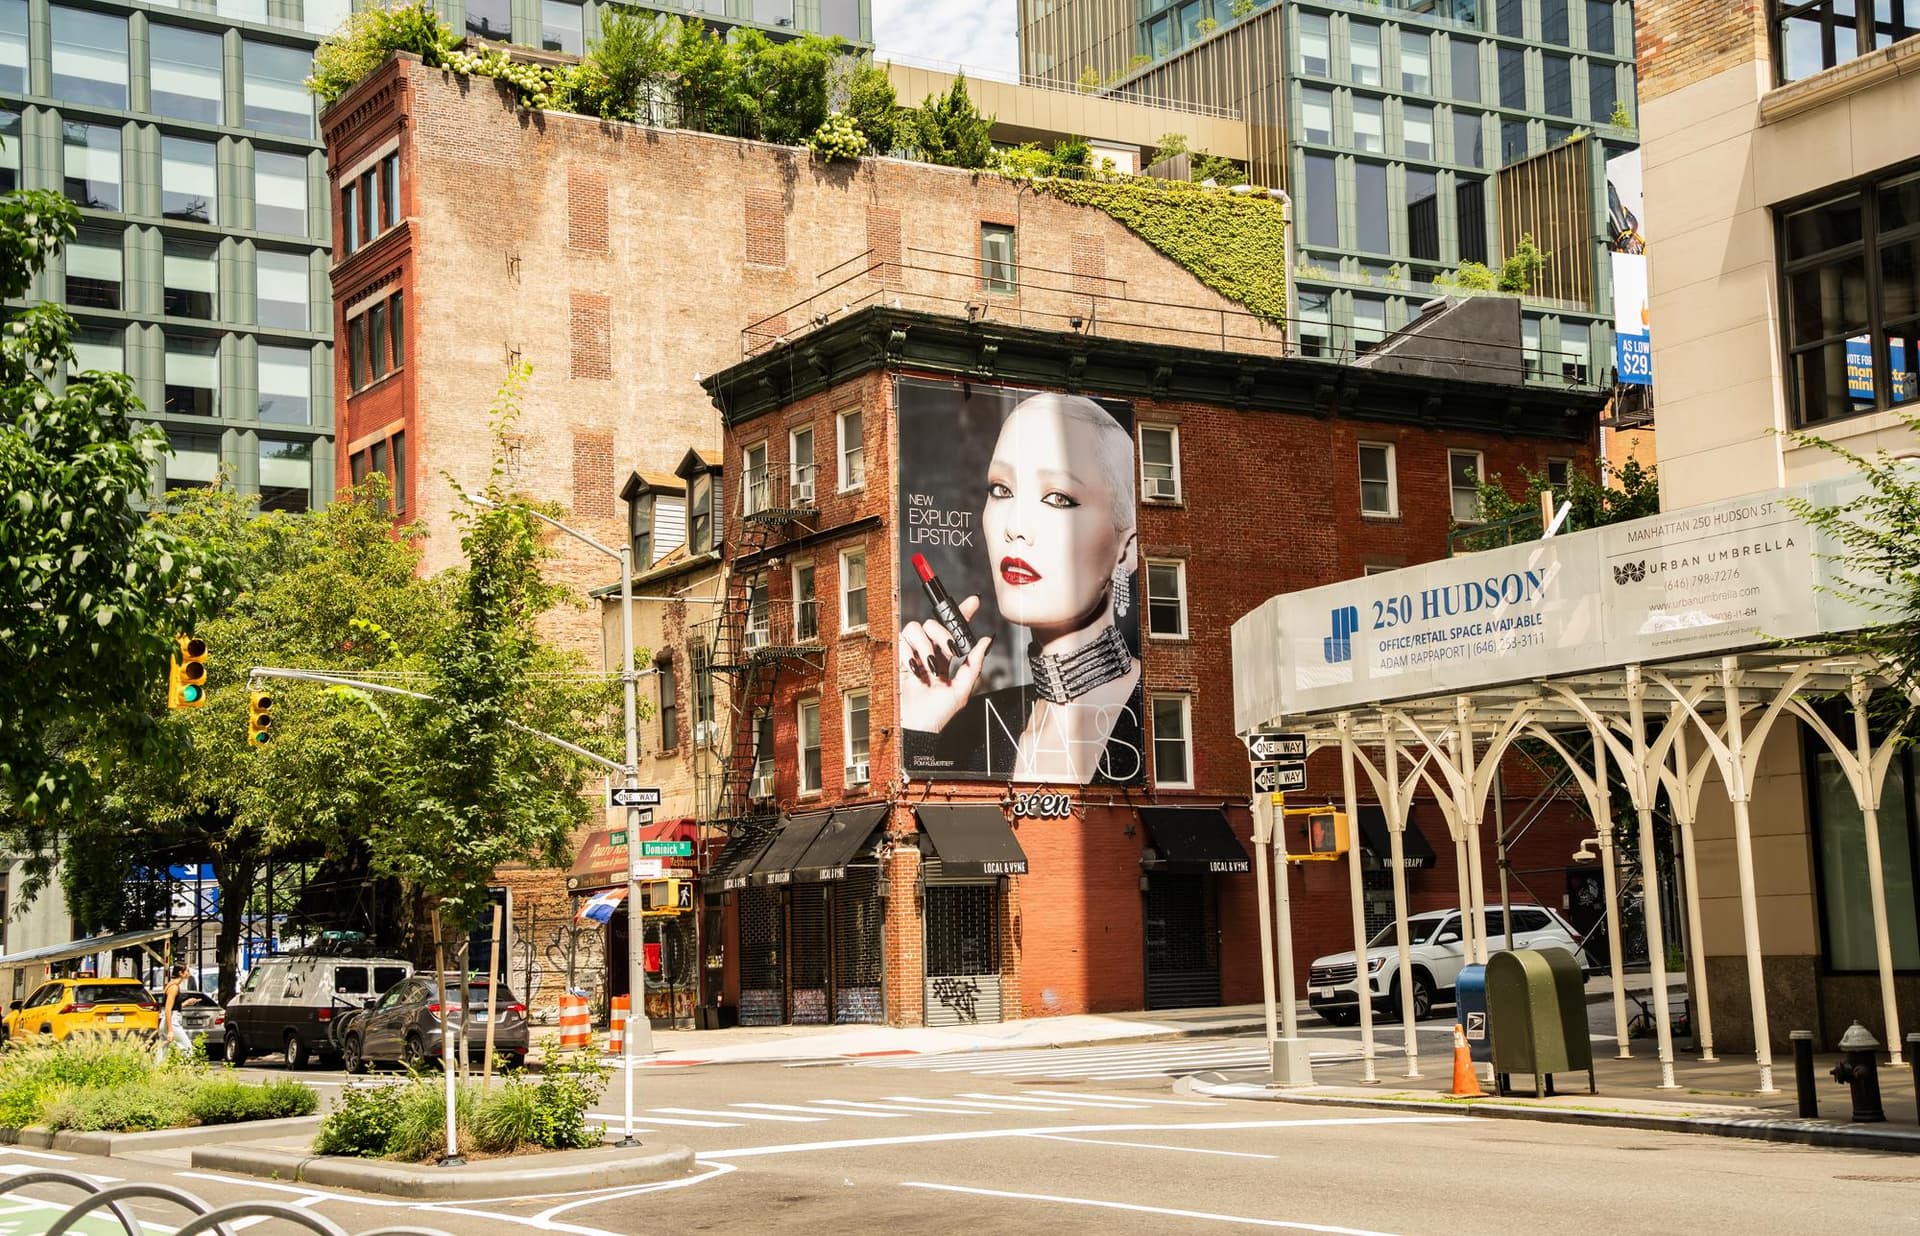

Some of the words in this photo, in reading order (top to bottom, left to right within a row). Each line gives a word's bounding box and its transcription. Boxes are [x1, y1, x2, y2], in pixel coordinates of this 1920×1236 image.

[1623, 339, 1632, 352] AS
[1634, 341, 1650, 353] LOW
[1847, 353, 1860, 365] VOTE
[909, 493, 934, 506] NEW
[909, 508, 972, 528] EXPLICIT
[1627, 520, 1690, 543] MANHATTAN
[1692, 515, 1711, 529] 250
[1714, 505, 1758, 524] HUDSON
[1761, 502, 1776, 516] ST.
[909, 527, 973, 547] LIPSTICK
[1650, 555, 1700, 574] URBAN
[1708, 537, 1795, 563] UMBRELLA
[1664, 578, 1689, 592] (646)
[1692, 568, 1740, 586] 798-7276
[1372, 595, 1412, 630] 250
[1421, 568, 1546, 620] HUDSON
[1379, 629, 1447, 652] OFFICE/RETAIL
[1450, 623, 1482, 640] SPACE
[1485, 613, 1542, 635] AVAILABLE
[1380, 653, 1408, 670] ADAM
[1411, 645, 1464, 665] RAPPAPORT
[1473, 640, 1496, 657] (646)
[985, 698, 1140, 781] NARS
[1257, 743, 1274, 753] ONE
[1283, 742, 1301, 753] WAY
[1261, 774, 1275, 785] ONE
[1284, 771, 1301, 783] WAY
[619, 793, 633, 802] ONE
[639, 793, 655, 802] WAY
[1013, 792, 1071, 816] seen
[645, 842, 678, 855] Dominick
[983, 862, 1003, 874] LOCAL
[1004, 862, 1009, 873] &
[1210, 861, 1228, 872] LOCAL
[1228, 861, 1233, 872] &
